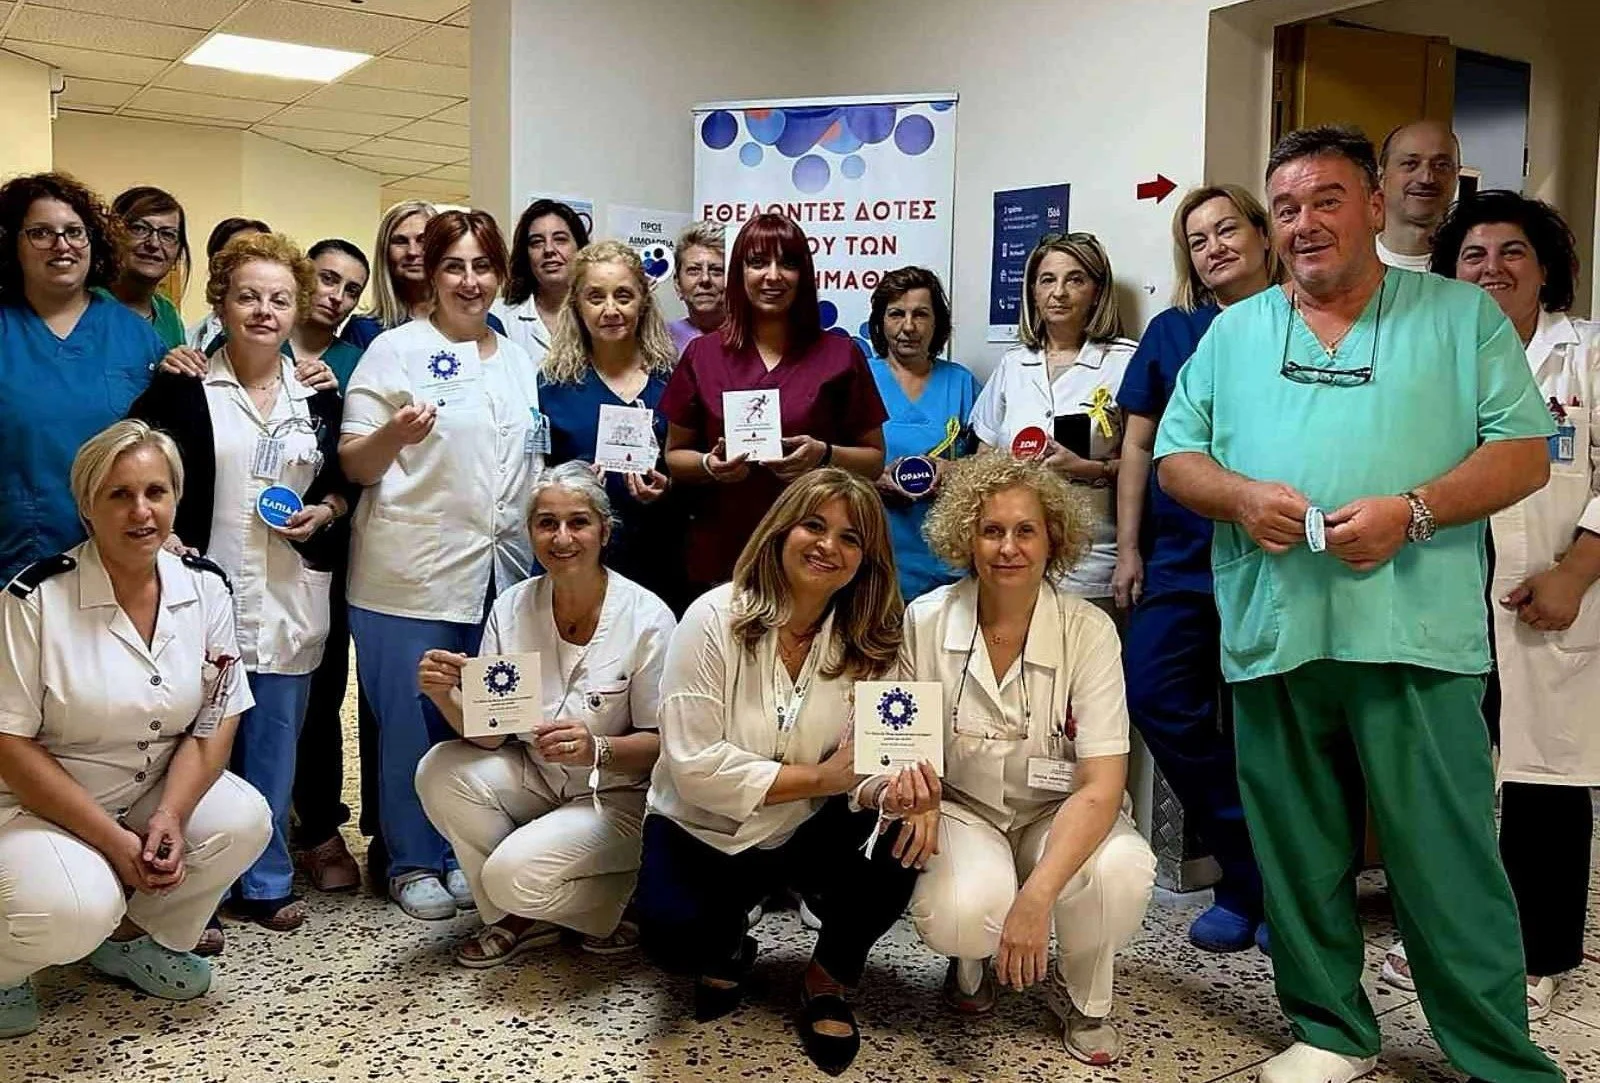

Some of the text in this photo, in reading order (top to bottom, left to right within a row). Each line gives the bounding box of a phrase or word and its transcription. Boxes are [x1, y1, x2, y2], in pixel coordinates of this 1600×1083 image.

[703, 200, 936, 222] ΕΘΕΛΟΝΤΕΣ ΔΟΤΕΣ
[640, 221, 662, 232] ΠΡΟΣ
[845, 235, 897, 256] ΤΩΝ
